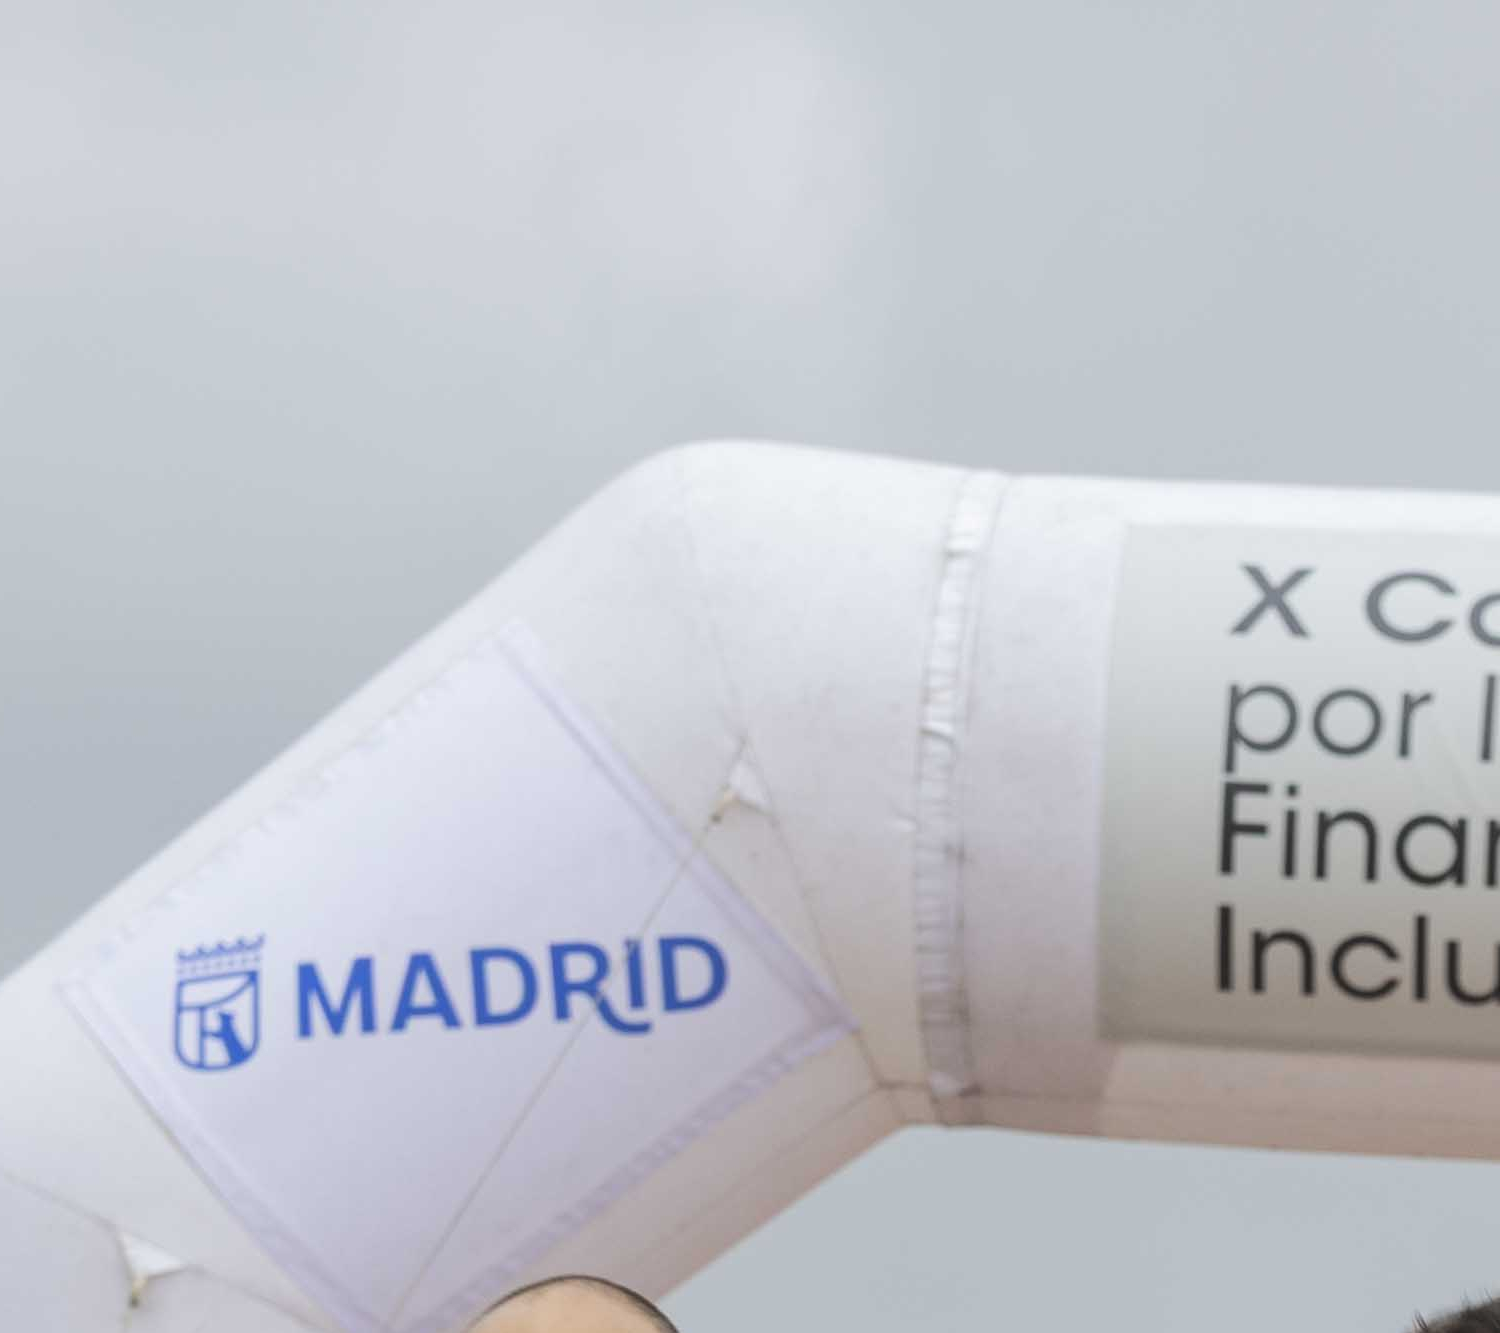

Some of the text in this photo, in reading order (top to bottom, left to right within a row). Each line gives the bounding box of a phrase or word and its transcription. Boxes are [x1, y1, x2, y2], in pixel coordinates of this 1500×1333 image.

[1230, 563, 1315, 639] X
[1224, 683, 1434, 774] por
[296, 936, 728, 1040] MADRID
